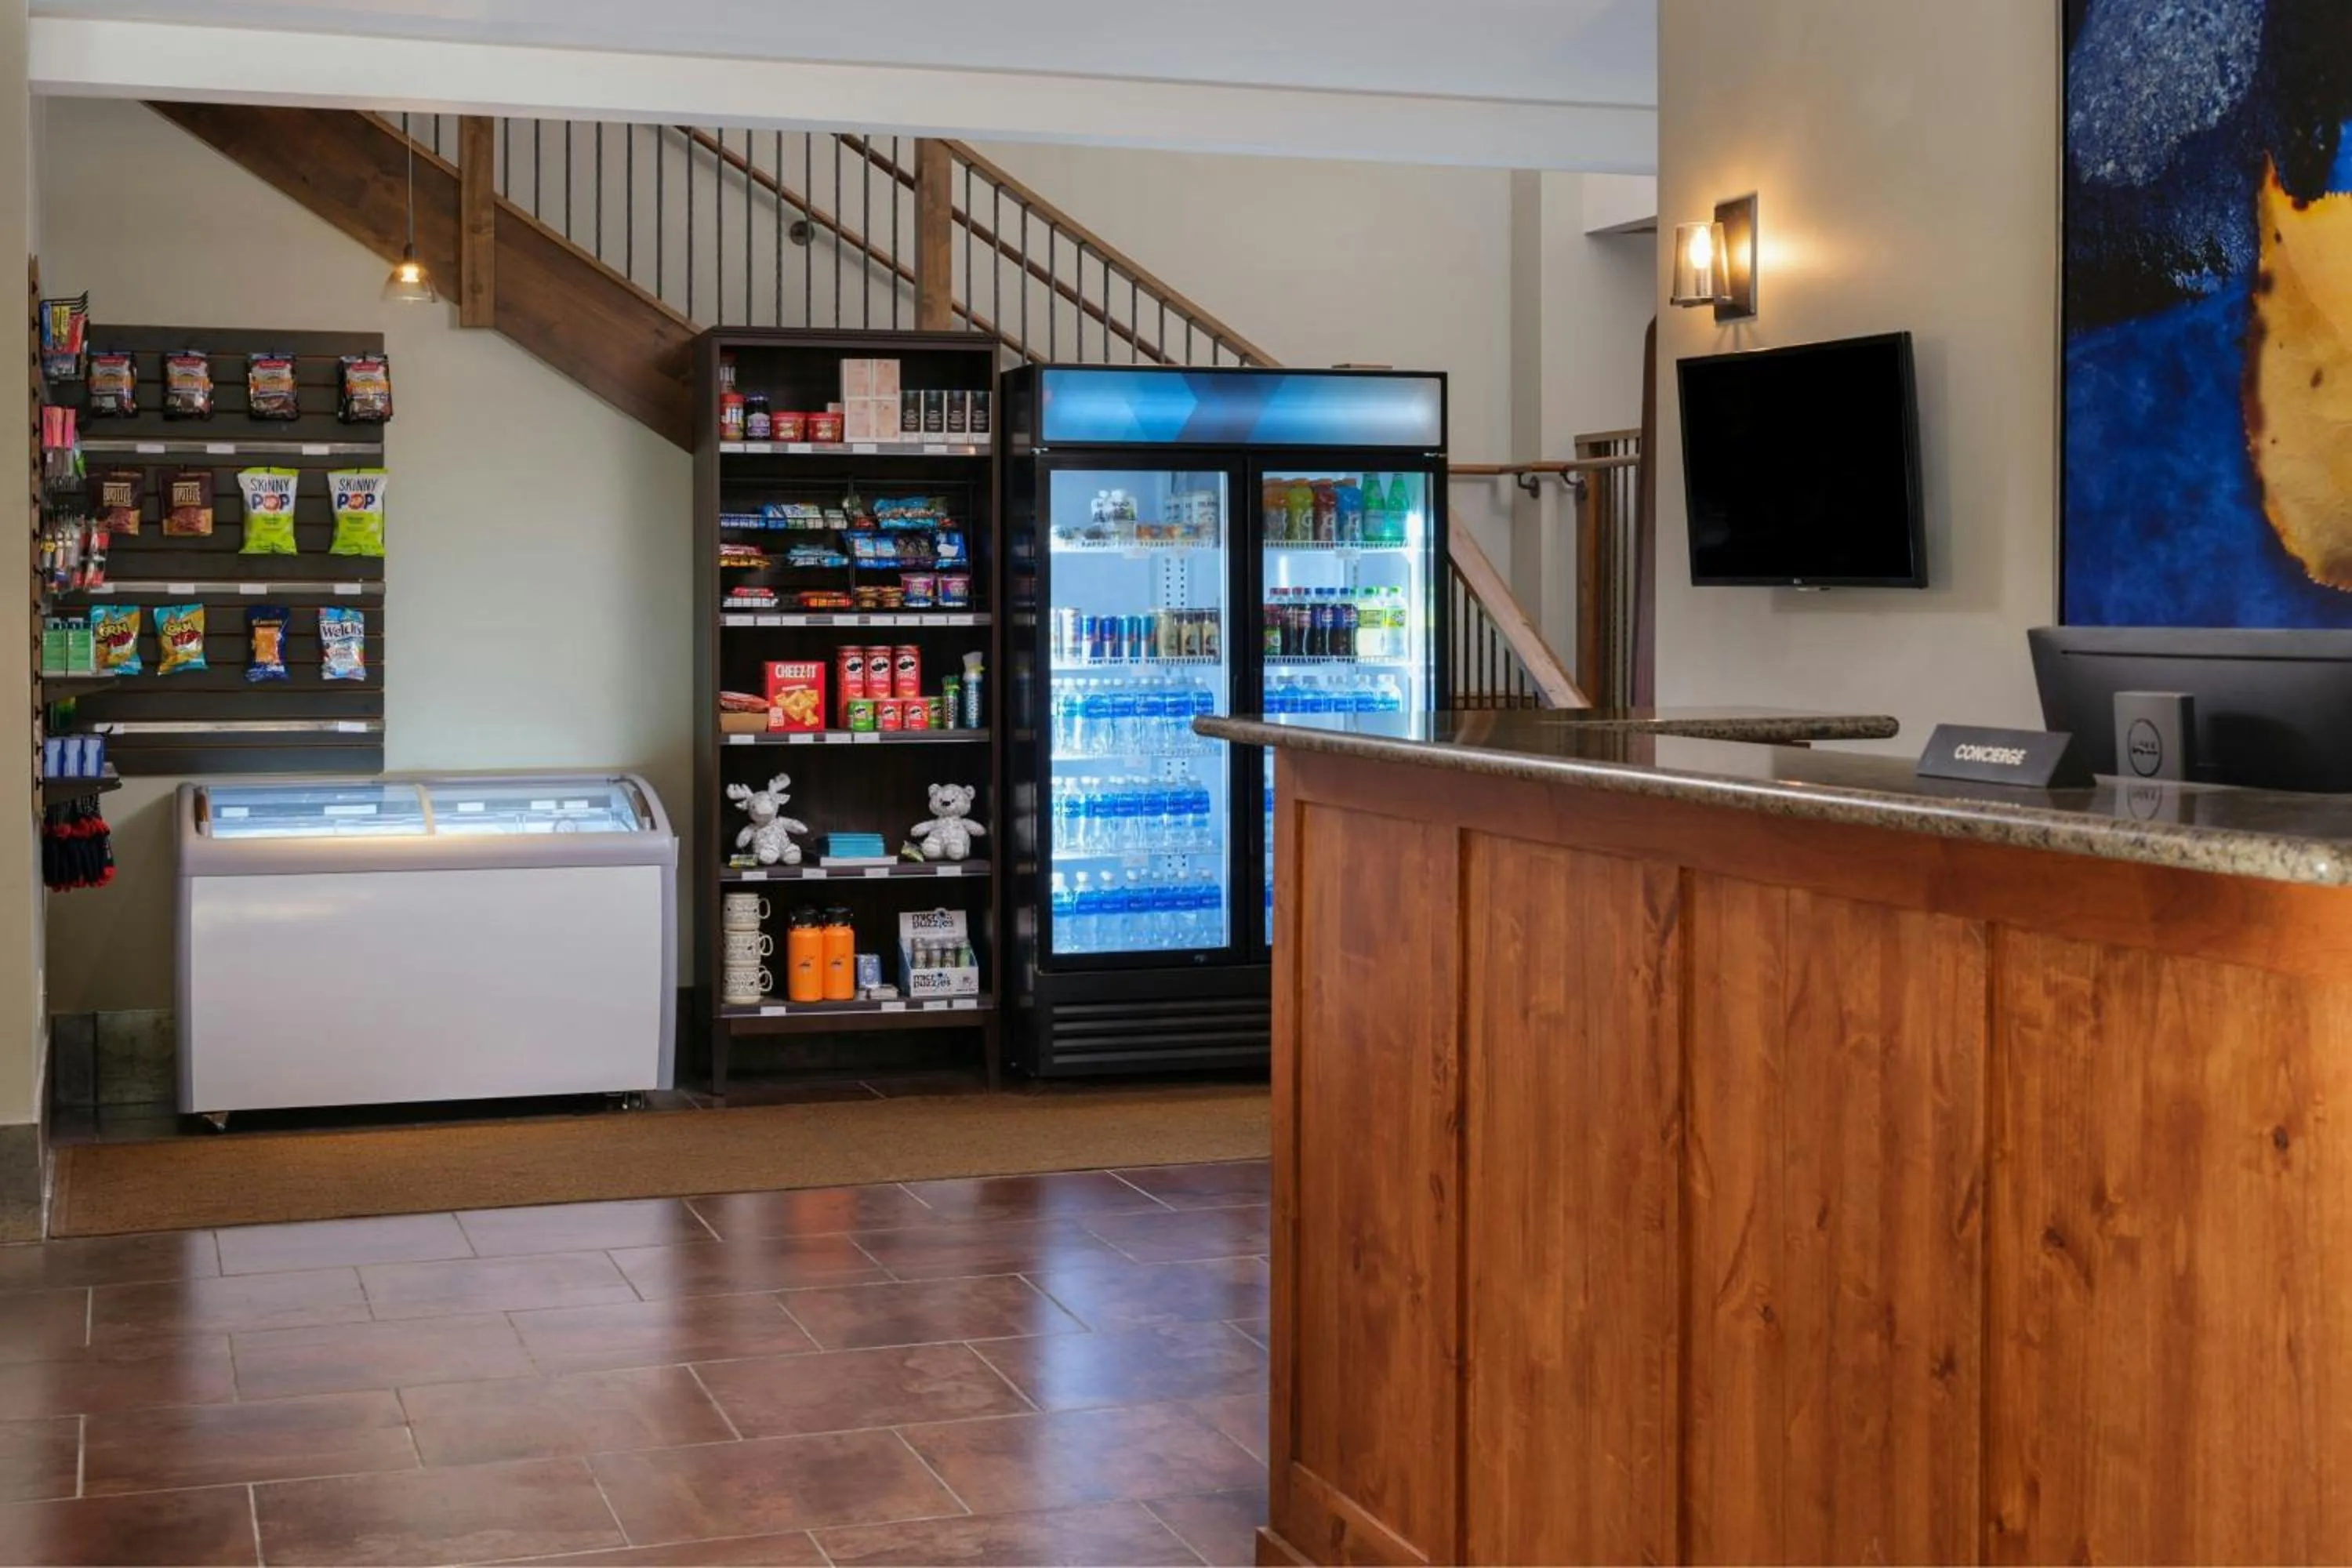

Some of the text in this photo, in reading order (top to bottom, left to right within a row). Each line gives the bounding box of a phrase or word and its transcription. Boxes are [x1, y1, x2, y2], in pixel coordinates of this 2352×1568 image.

[338, 478, 377, 492] SKINNY
[251, 493, 290, 510] POP
[337, 494, 376, 510] POP
[1954, 743, 2027, 765] CONCIERGE
